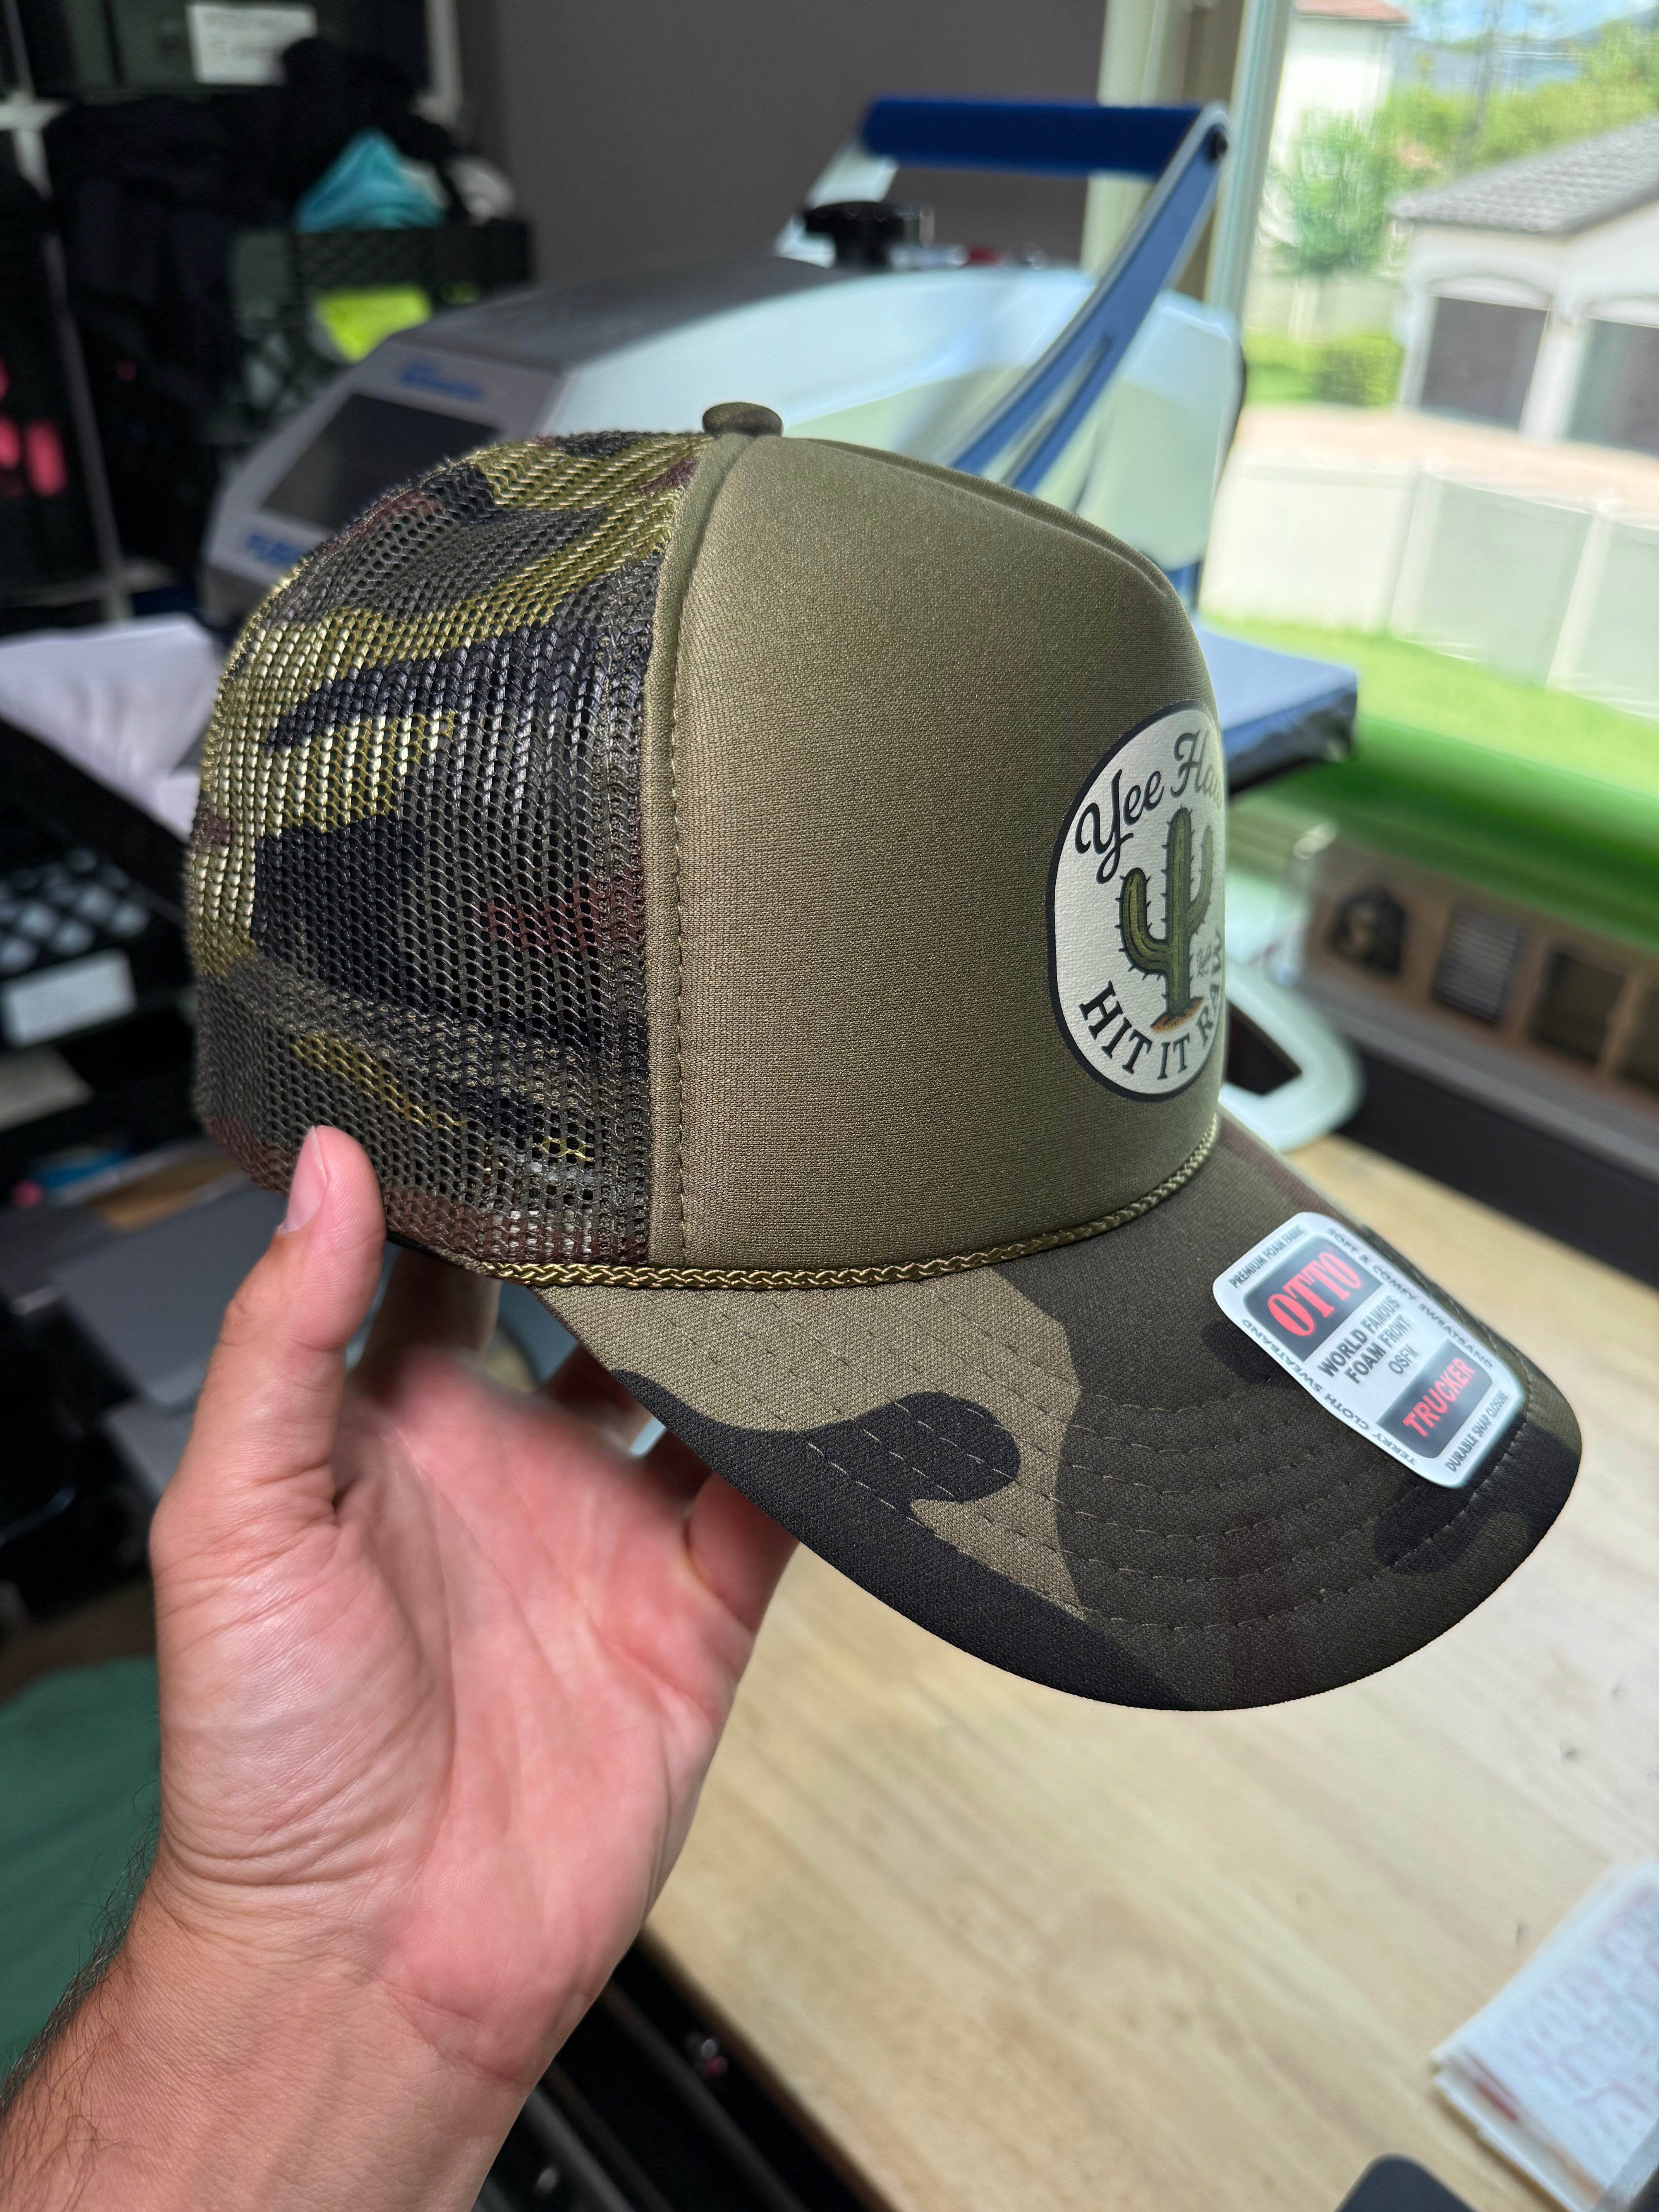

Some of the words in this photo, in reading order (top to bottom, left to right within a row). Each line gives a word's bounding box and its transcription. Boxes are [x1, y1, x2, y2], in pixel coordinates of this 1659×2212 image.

[1075, 769, 1164, 884] Yee
[1079, 981, 1152, 1075] HIT
[1157, 1033, 1190, 1080] IT
[1228, 1255, 1267, 1288] PREMIUM
[1262, 1242, 1286, 1259] FOAM
[1281, 1224, 1306, 1246] FABRIC
[1268, 1252, 1360, 1336] OTTO
[1317, 1328, 1367, 1377] WORLD
[1360, 1295, 1400, 1334] FAMOUS
[1327, 1228, 1361, 1254] SOFT
[1372, 1264, 1417, 1300] COMFY
[1417, 1303, 1493, 1368] SWEATBAND
[1243, 1319, 1322, 1392] SWEATBAND
[1344, 1341, 1386, 1384] FOAM
[1378, 1314, 1411, 1348] FRONT
[1388, 1343, 1419, 1374] OSFM
[1325, 1393, 1369, 1430] CLOTH
[1403, 1357, 1475, 1437] TRUCKER
[1444, 1434, 1478, 1472] DURABLE
[1471, 1417, 1492, 1437] SNAP
[1486, 1390, 1508, 1418] CLOSURE
[1372, 1432, 1416, 1465] TERRY
